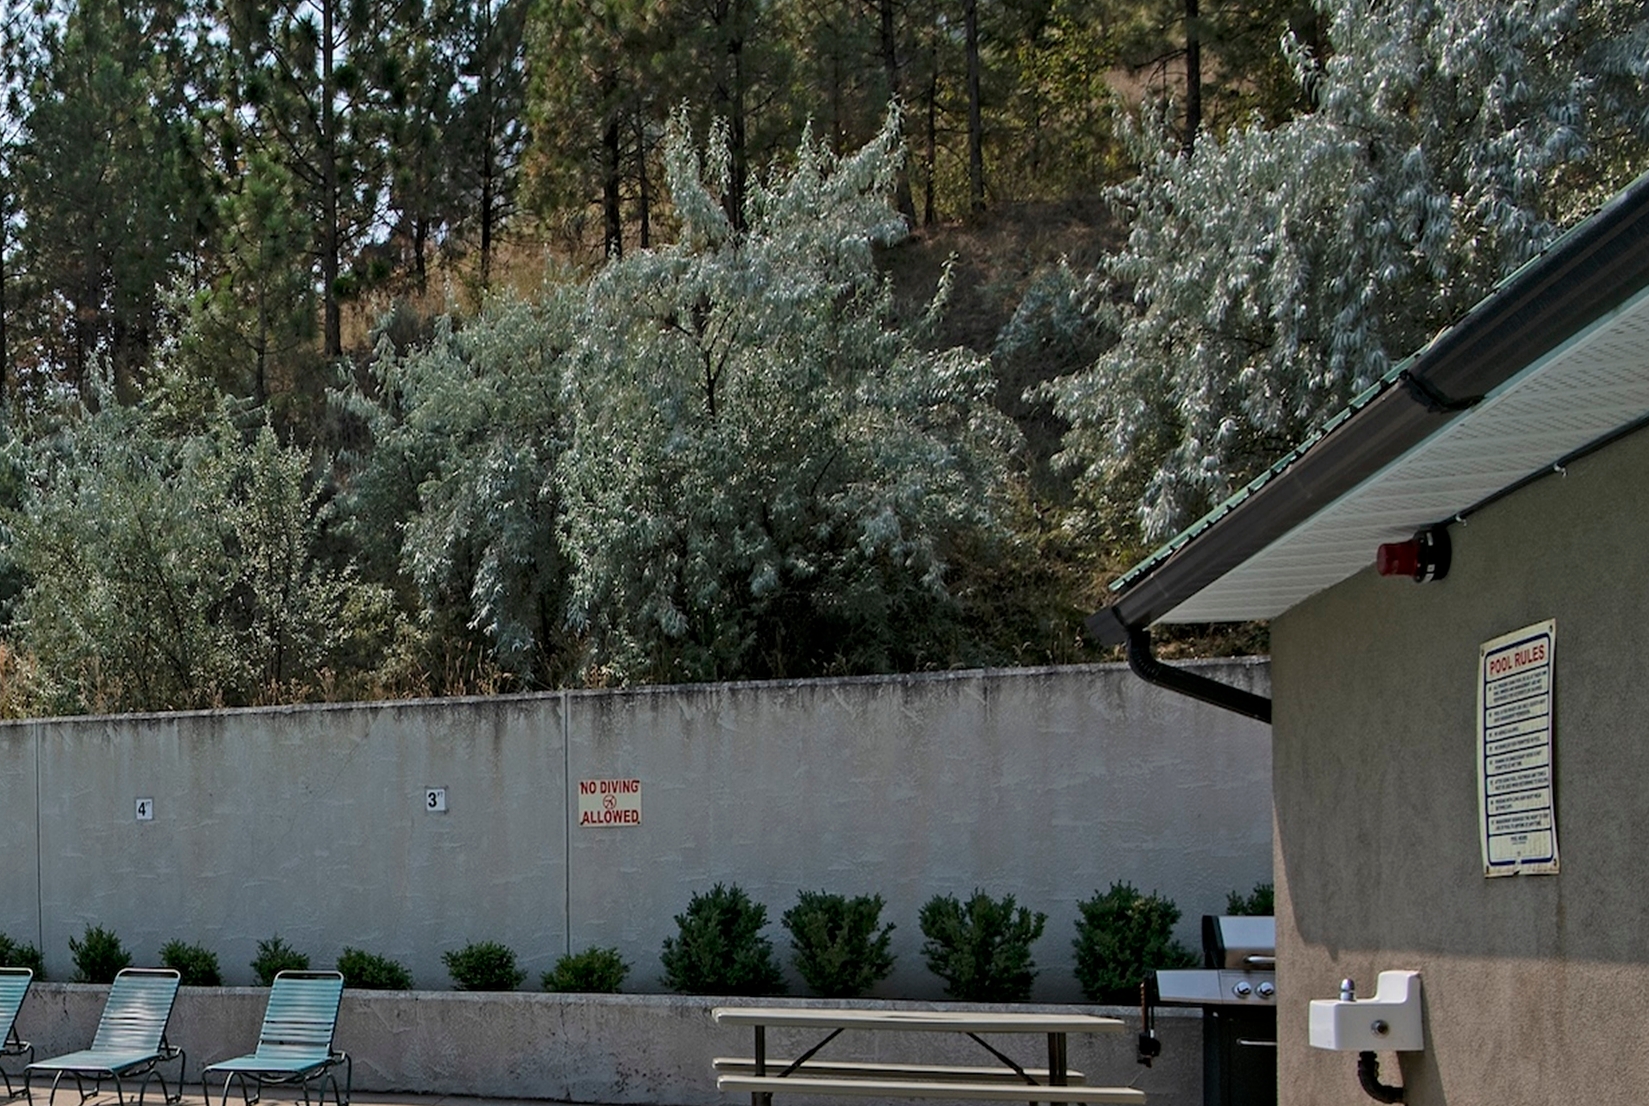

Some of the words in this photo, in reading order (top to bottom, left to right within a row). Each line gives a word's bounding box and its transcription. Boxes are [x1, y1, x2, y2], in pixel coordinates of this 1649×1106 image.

[1489, 656, 1513, 675] POOL
[1514, 644, 1545, 667] RULES
[580, 781, 597, 794] NO
[600, 780, 639, 794] DIVING
[428, 792, 437, 808] 3
[138, 801, 146, 816] 4
[582, 810, 639, 824] ALLOWED
